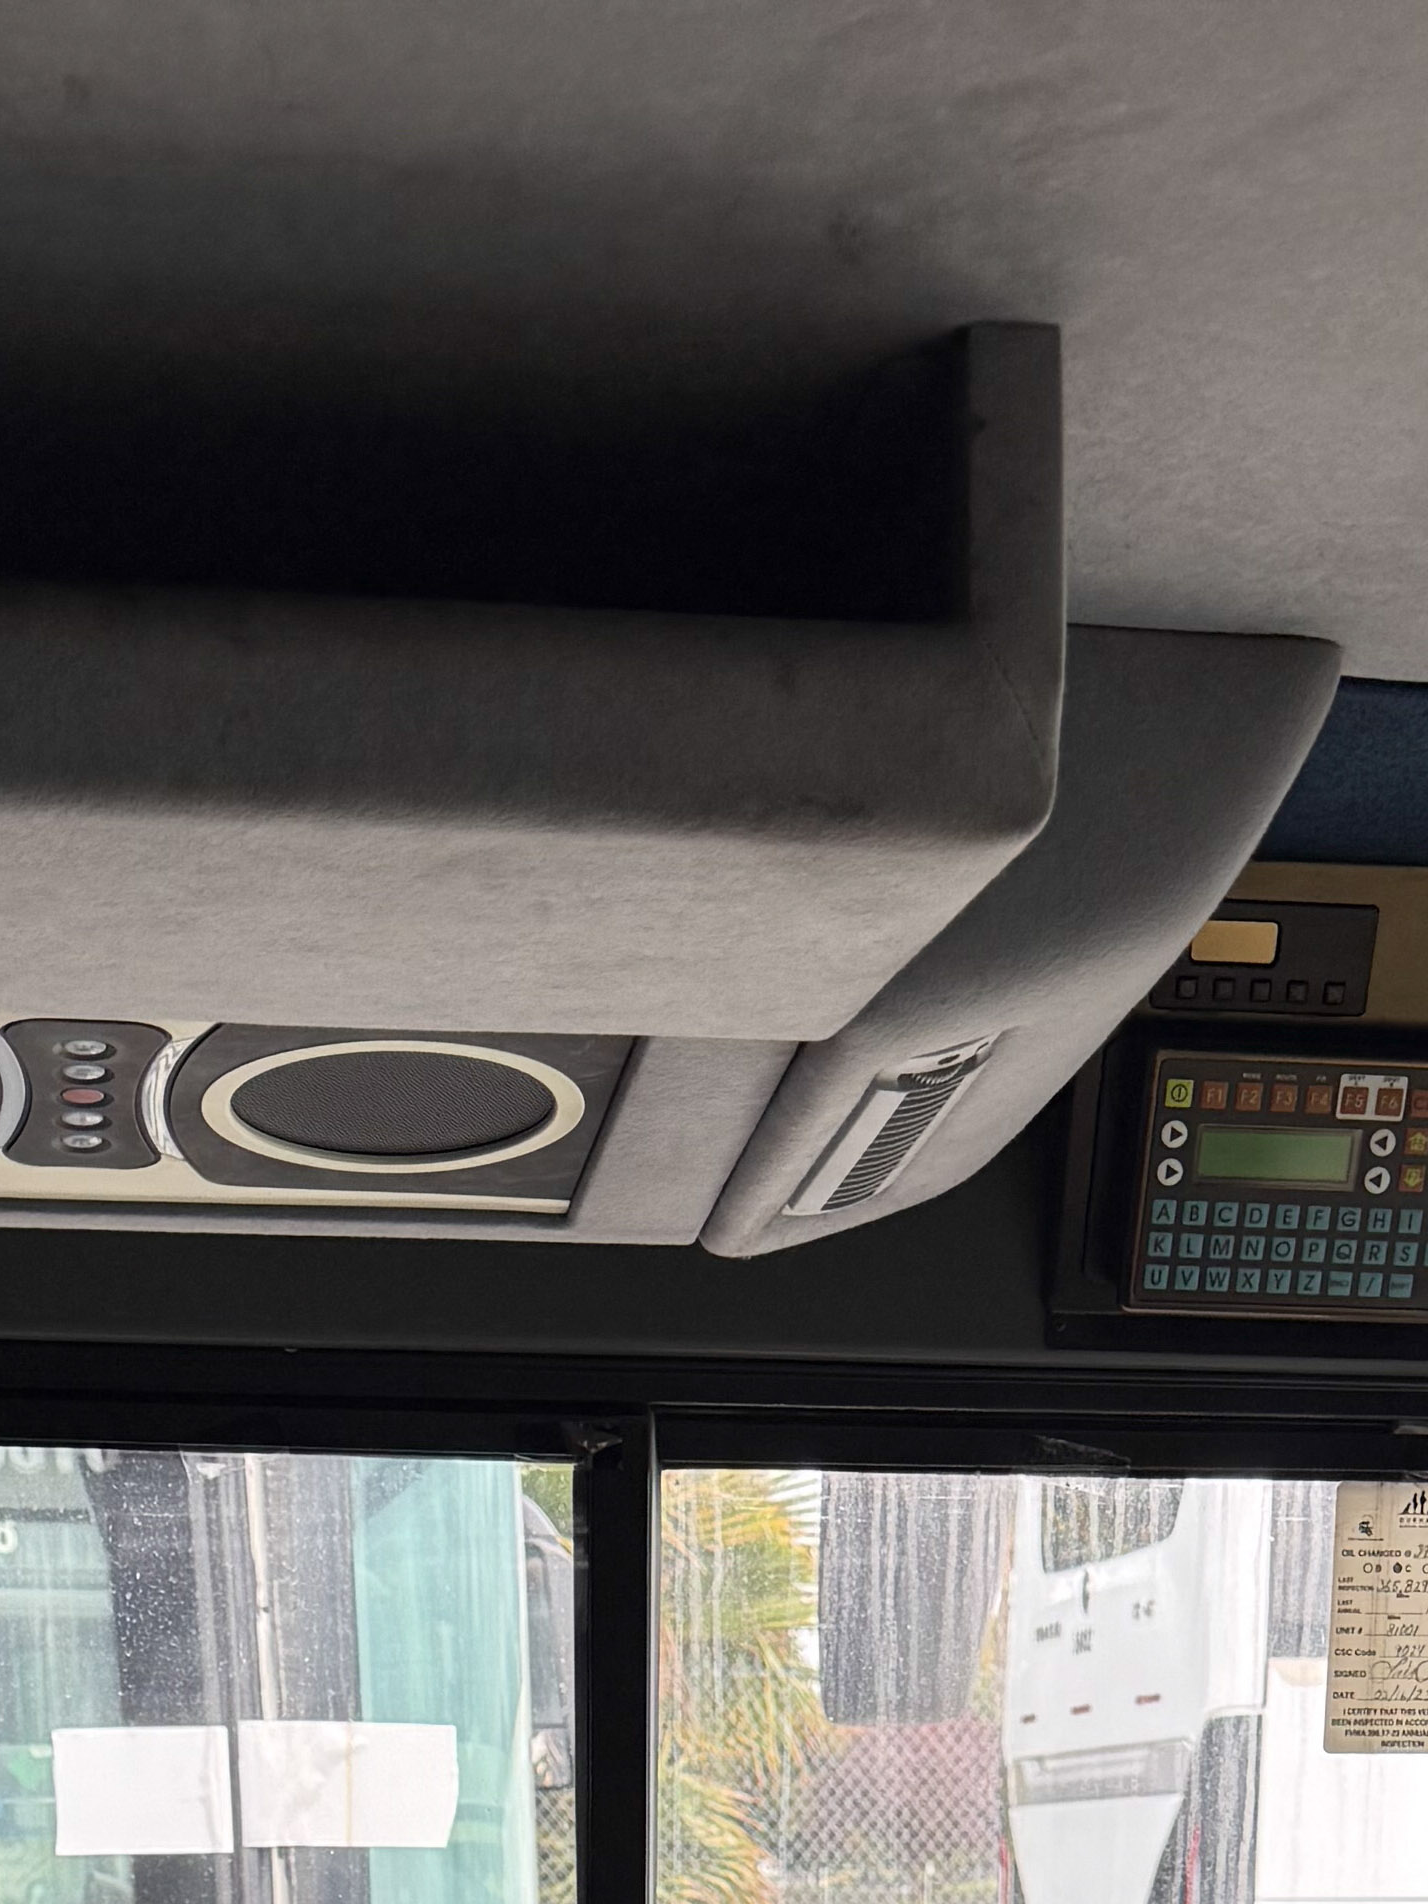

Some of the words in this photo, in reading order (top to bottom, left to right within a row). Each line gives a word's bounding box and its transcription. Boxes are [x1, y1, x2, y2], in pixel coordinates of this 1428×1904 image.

[1207, 1089, 1222, 1103] F1
[1240, 1090, 1259, 1104] F2
[1276, 1091, 1294, 1106] F3
[1310, 1093, 1329, 1106] F4
[1345, 1095, 1363, 1109] F5
[1380, 1096, 1399, 1109] F6
[1334, 1670, 1367, 1678] SIGNED
